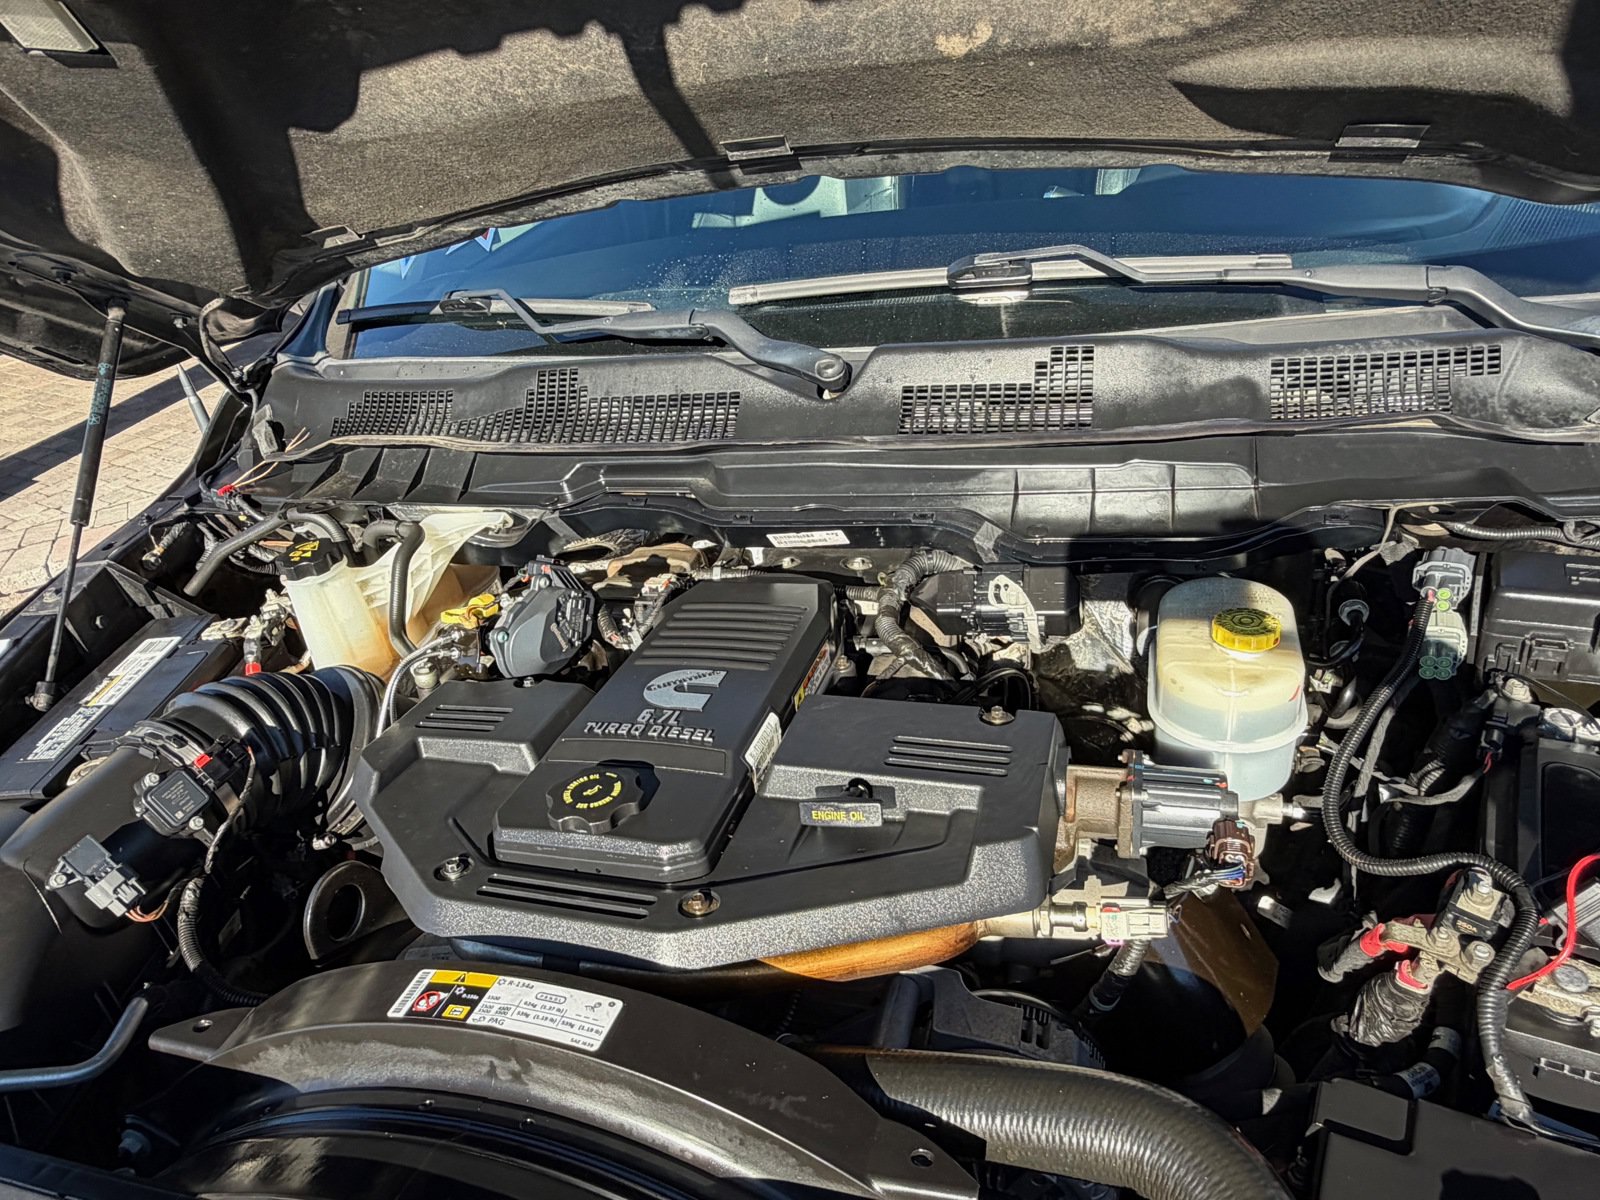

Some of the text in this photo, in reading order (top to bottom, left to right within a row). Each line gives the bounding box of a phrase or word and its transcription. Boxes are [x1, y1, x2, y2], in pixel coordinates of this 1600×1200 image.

[637, 708, 681, 725] 6.7L
[583, 721, 714, 743] TURBO DIESEL
[811, 810, 866, 821] ENGINE OIL
[507, 981, 535, 989] R-134a
[487, 1017, 505, 1026] PAG
